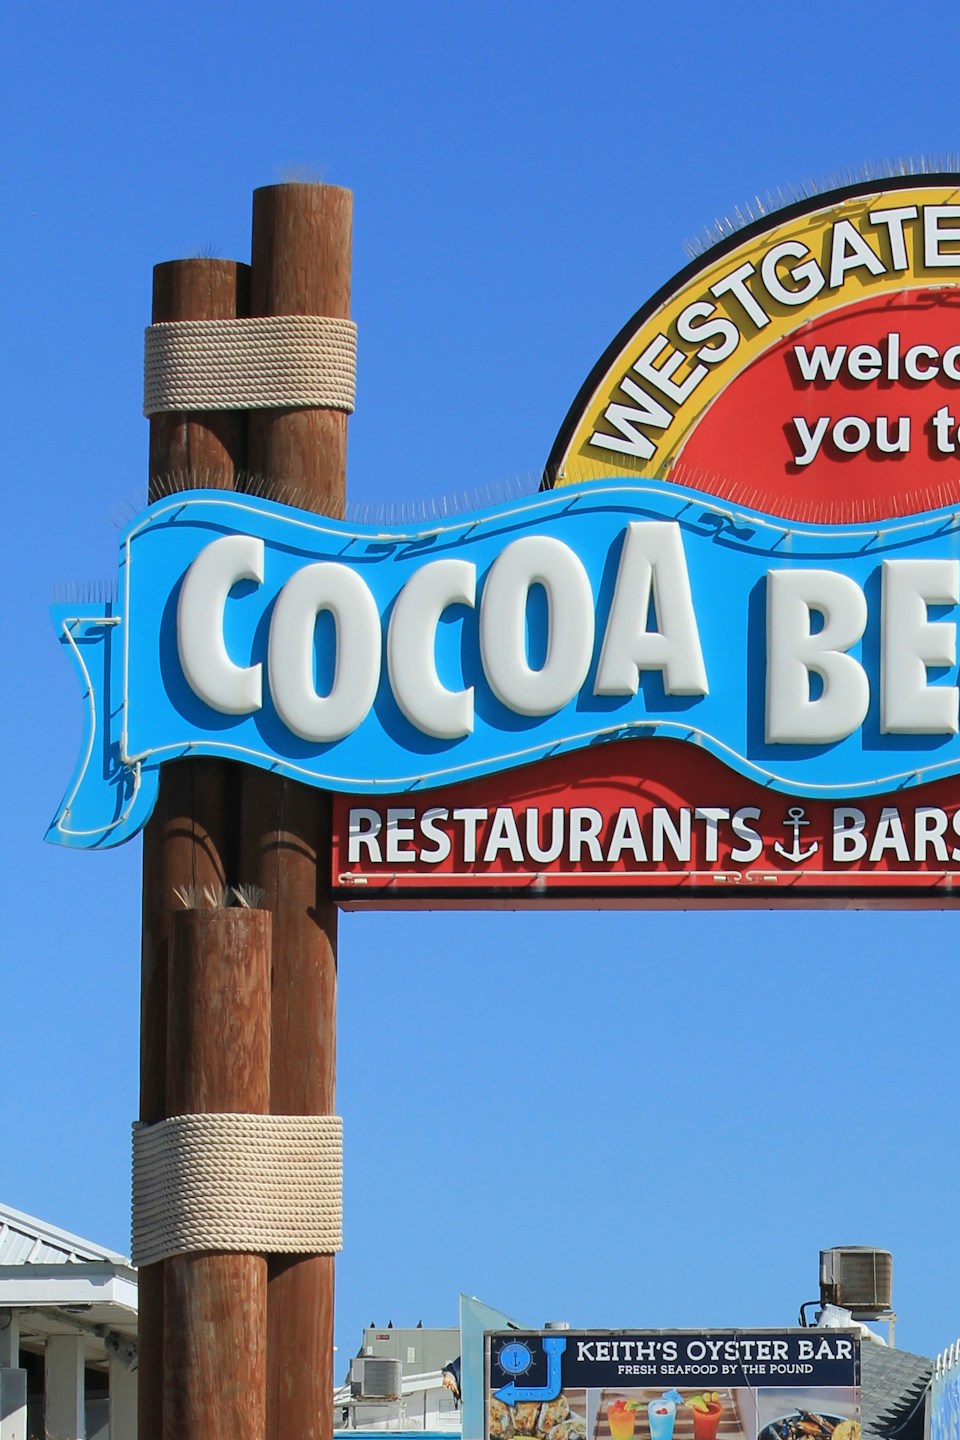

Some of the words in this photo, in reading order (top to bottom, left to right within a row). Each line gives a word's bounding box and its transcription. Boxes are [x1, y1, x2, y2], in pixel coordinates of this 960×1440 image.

[792, 415, 912, 466] you
[176, 520, 709, 744] COCOA
[347, 806, 764, 864] RESTAURANTS
[577, 1340, 678, 1362] KEITH'S
[686, 1340, 789, 1361] OYSTER
[799, 1340, 852, 1361] BAR
[617, 1365, 658, 1375] FRESH
[660, 1364, 719, 1375] SEAFOOD
[721, 1364, 738, 1375] BY
[741, 1364, 766, 1375] THE
[769, 1364, 814, 1375] POUND
